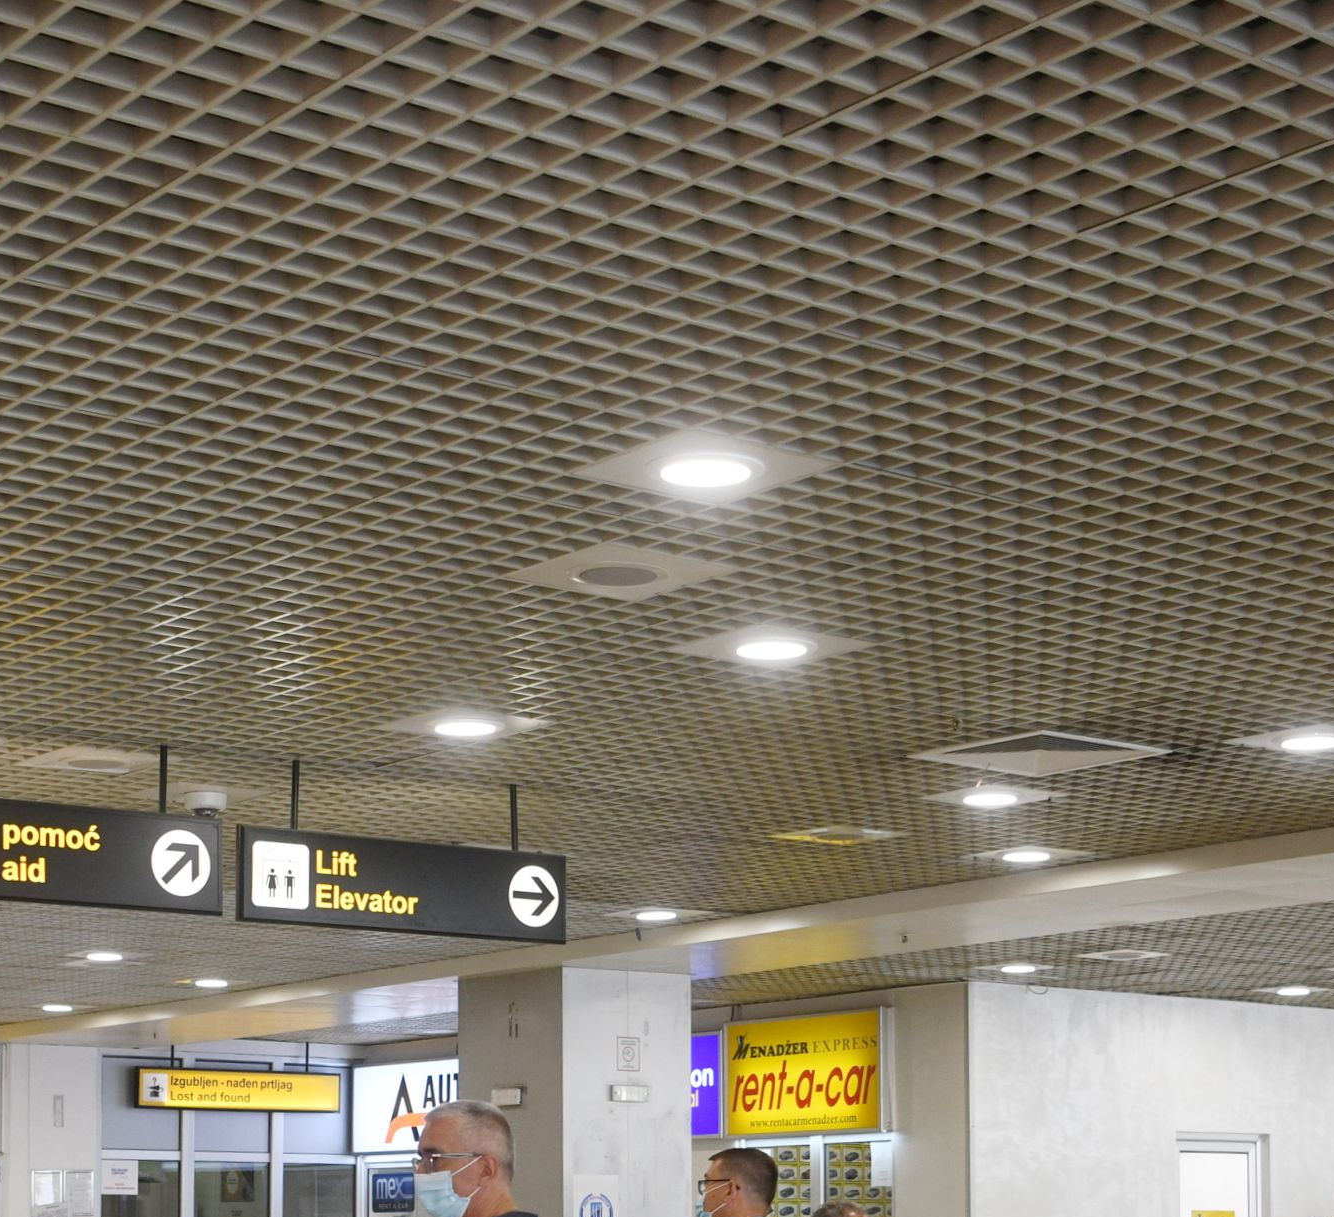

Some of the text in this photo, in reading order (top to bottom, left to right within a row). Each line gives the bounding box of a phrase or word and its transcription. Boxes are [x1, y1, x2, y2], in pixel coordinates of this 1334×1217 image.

[3, 822, 100, 851] pomoć
[2, 857, 46, 884] aid
[316, 850, 357, 877] Lift
[315, 884, 419, 915] Elevator
[813, 1036, 877, 1053] EXPRESS
[170, 1075, 218, 1088] Izgubljen
[260, 1077, 293, 1092] prtljag
[690, 1067, 714, 1088] on
[732, 1060, 876, 1113] rent-a-car
[170, 1091, 251, 1103] Lost and found
